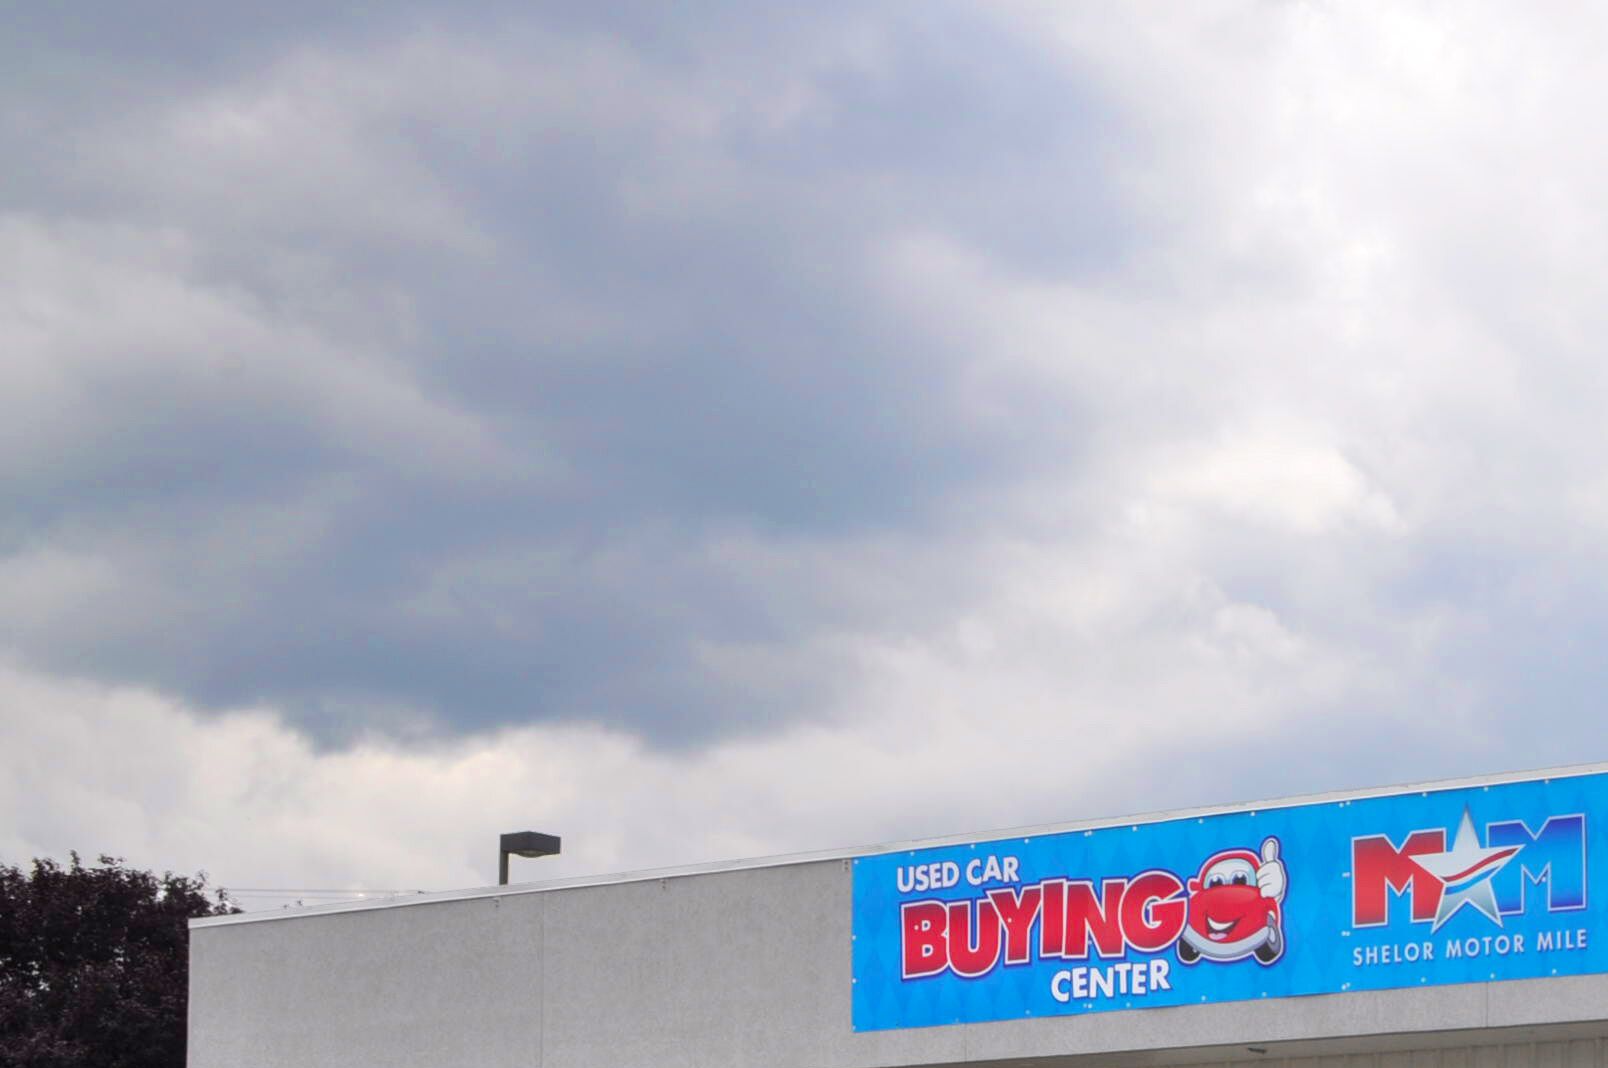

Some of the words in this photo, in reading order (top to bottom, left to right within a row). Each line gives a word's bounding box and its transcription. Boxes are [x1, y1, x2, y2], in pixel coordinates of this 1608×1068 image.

[897, 861, 960, 892] USED
[965, 856, 1020, 885] CAR
[902, 870, 1188, 979] BUYING
[1353, 942, 1434, 966] SHELOR
[1446, 935, 1525, 958] MOTOR
[1537, 929, 1587, 951] MILE
[1051, 959, 1171, 1002] CENTER
